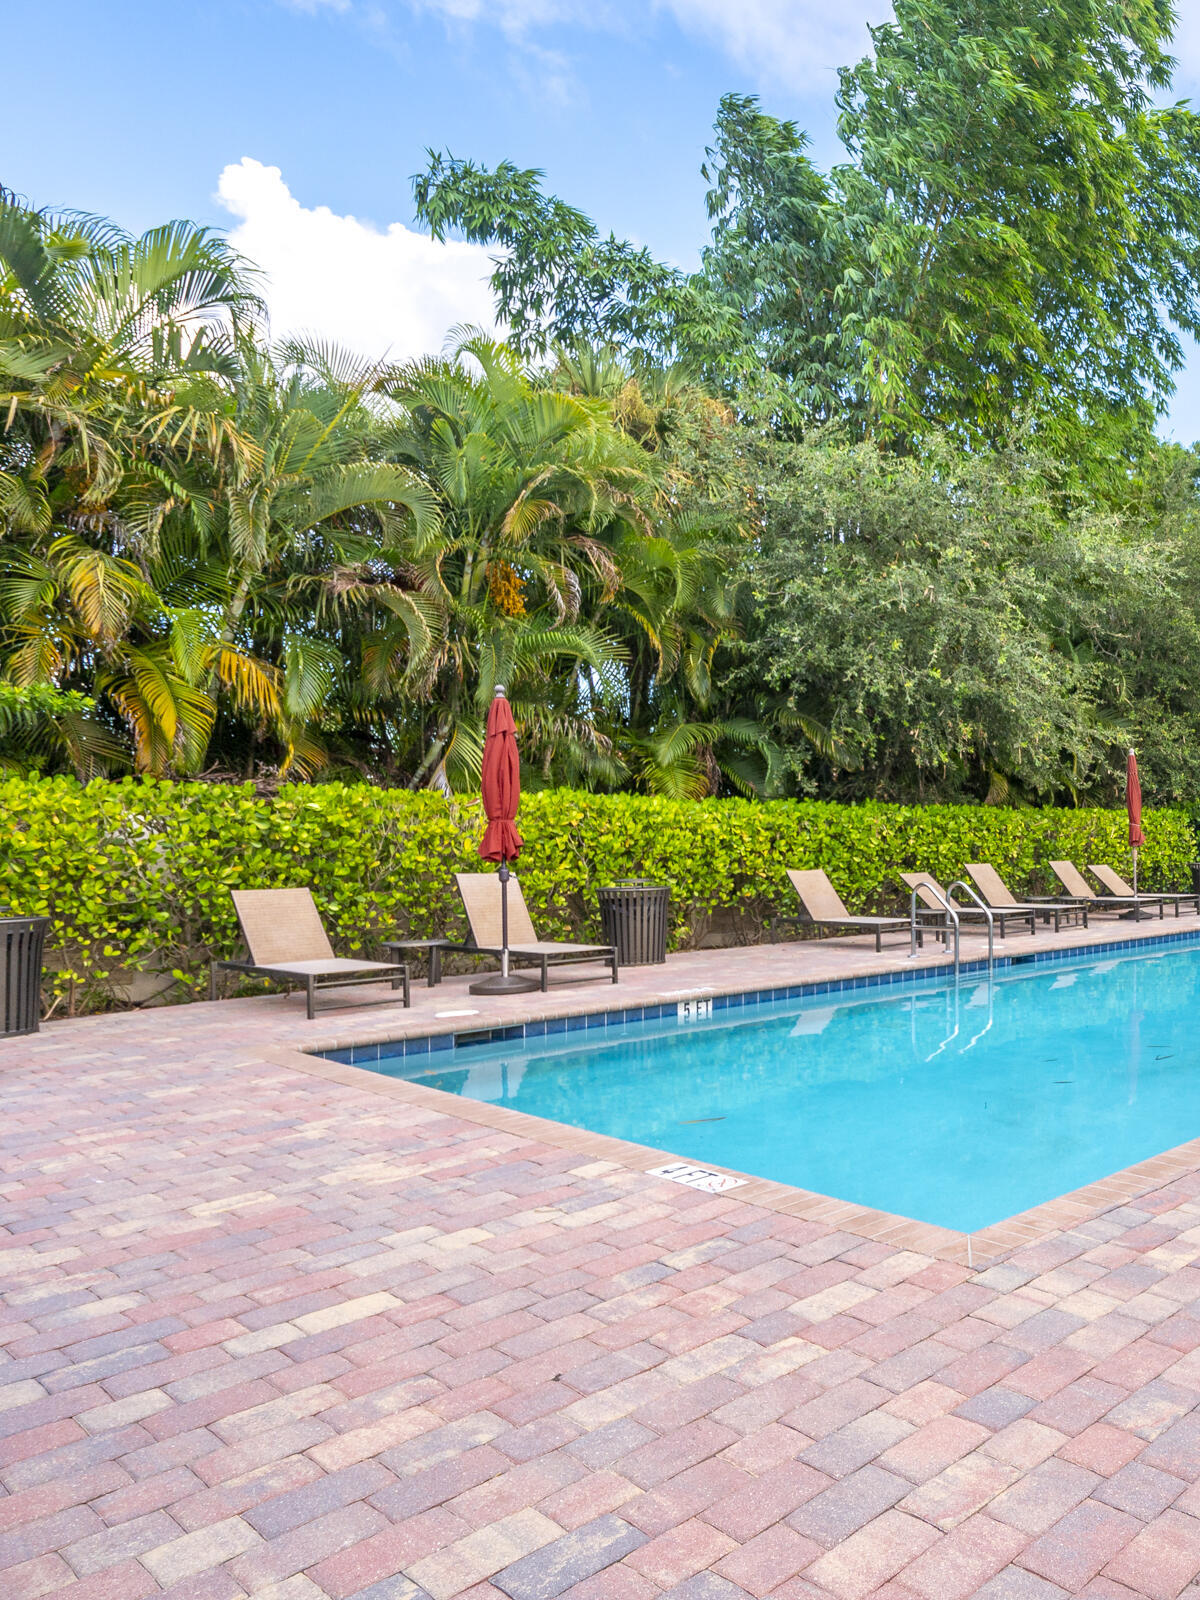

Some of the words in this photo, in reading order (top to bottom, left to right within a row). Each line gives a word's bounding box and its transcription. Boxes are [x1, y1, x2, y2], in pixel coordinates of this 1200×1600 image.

[684, 1002, 690, 1015] 5
[697, 999, 711, 1015] FT
[672, 1170, 719, 1183] FT
